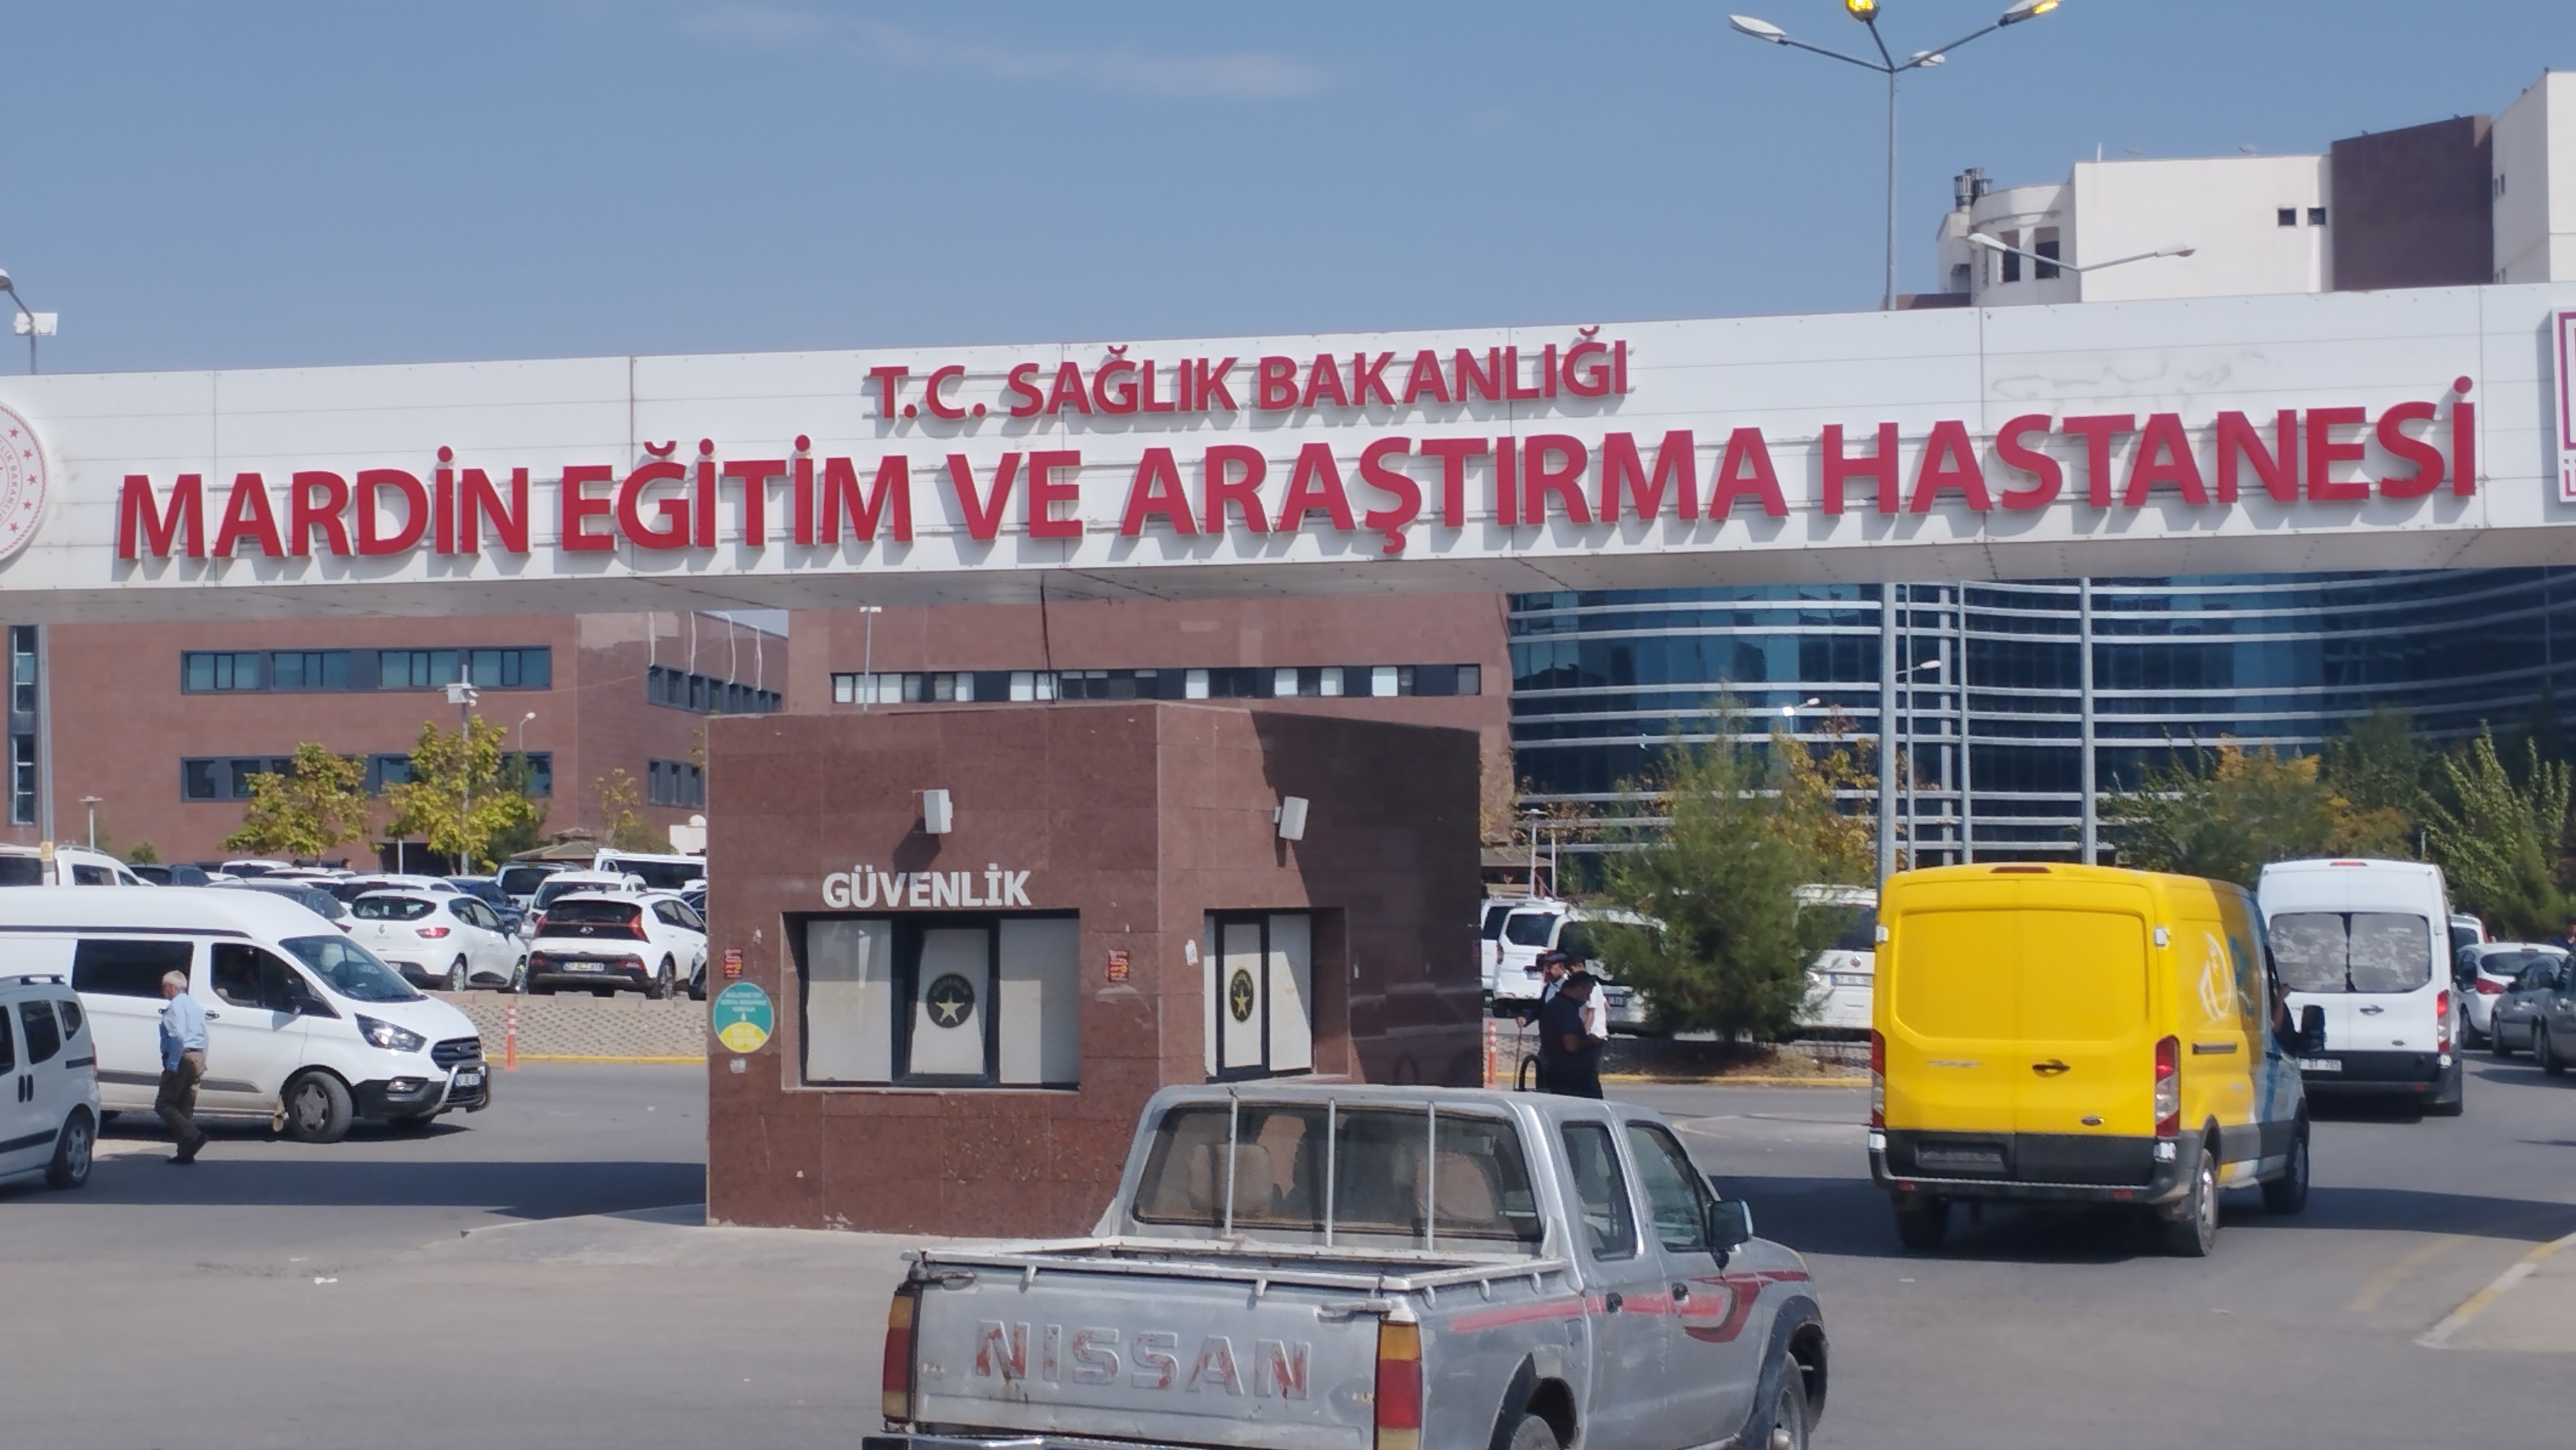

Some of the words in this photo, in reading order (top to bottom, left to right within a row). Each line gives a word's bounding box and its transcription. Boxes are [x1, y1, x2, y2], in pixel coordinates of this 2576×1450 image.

[870, 364, 986, 419] T.C.
[1008, 344, 1236, 417] SAĞLIK
[1258, 325, 1627, 410] BAKANLIĞI
[118, 445, 529, 560] MARDİN
[561, 434, 912, 551] EĞİTİM
[946, 450, 1082, 541] VE
[1120, 427, 1787, 554] ARAŞTIRMA
[1822, 376, 2476, 515] HASTANESİ
[822, 862, 1032, 909] GÜVENLİK
[975, 1319, 1312, 1400] NISSAN
